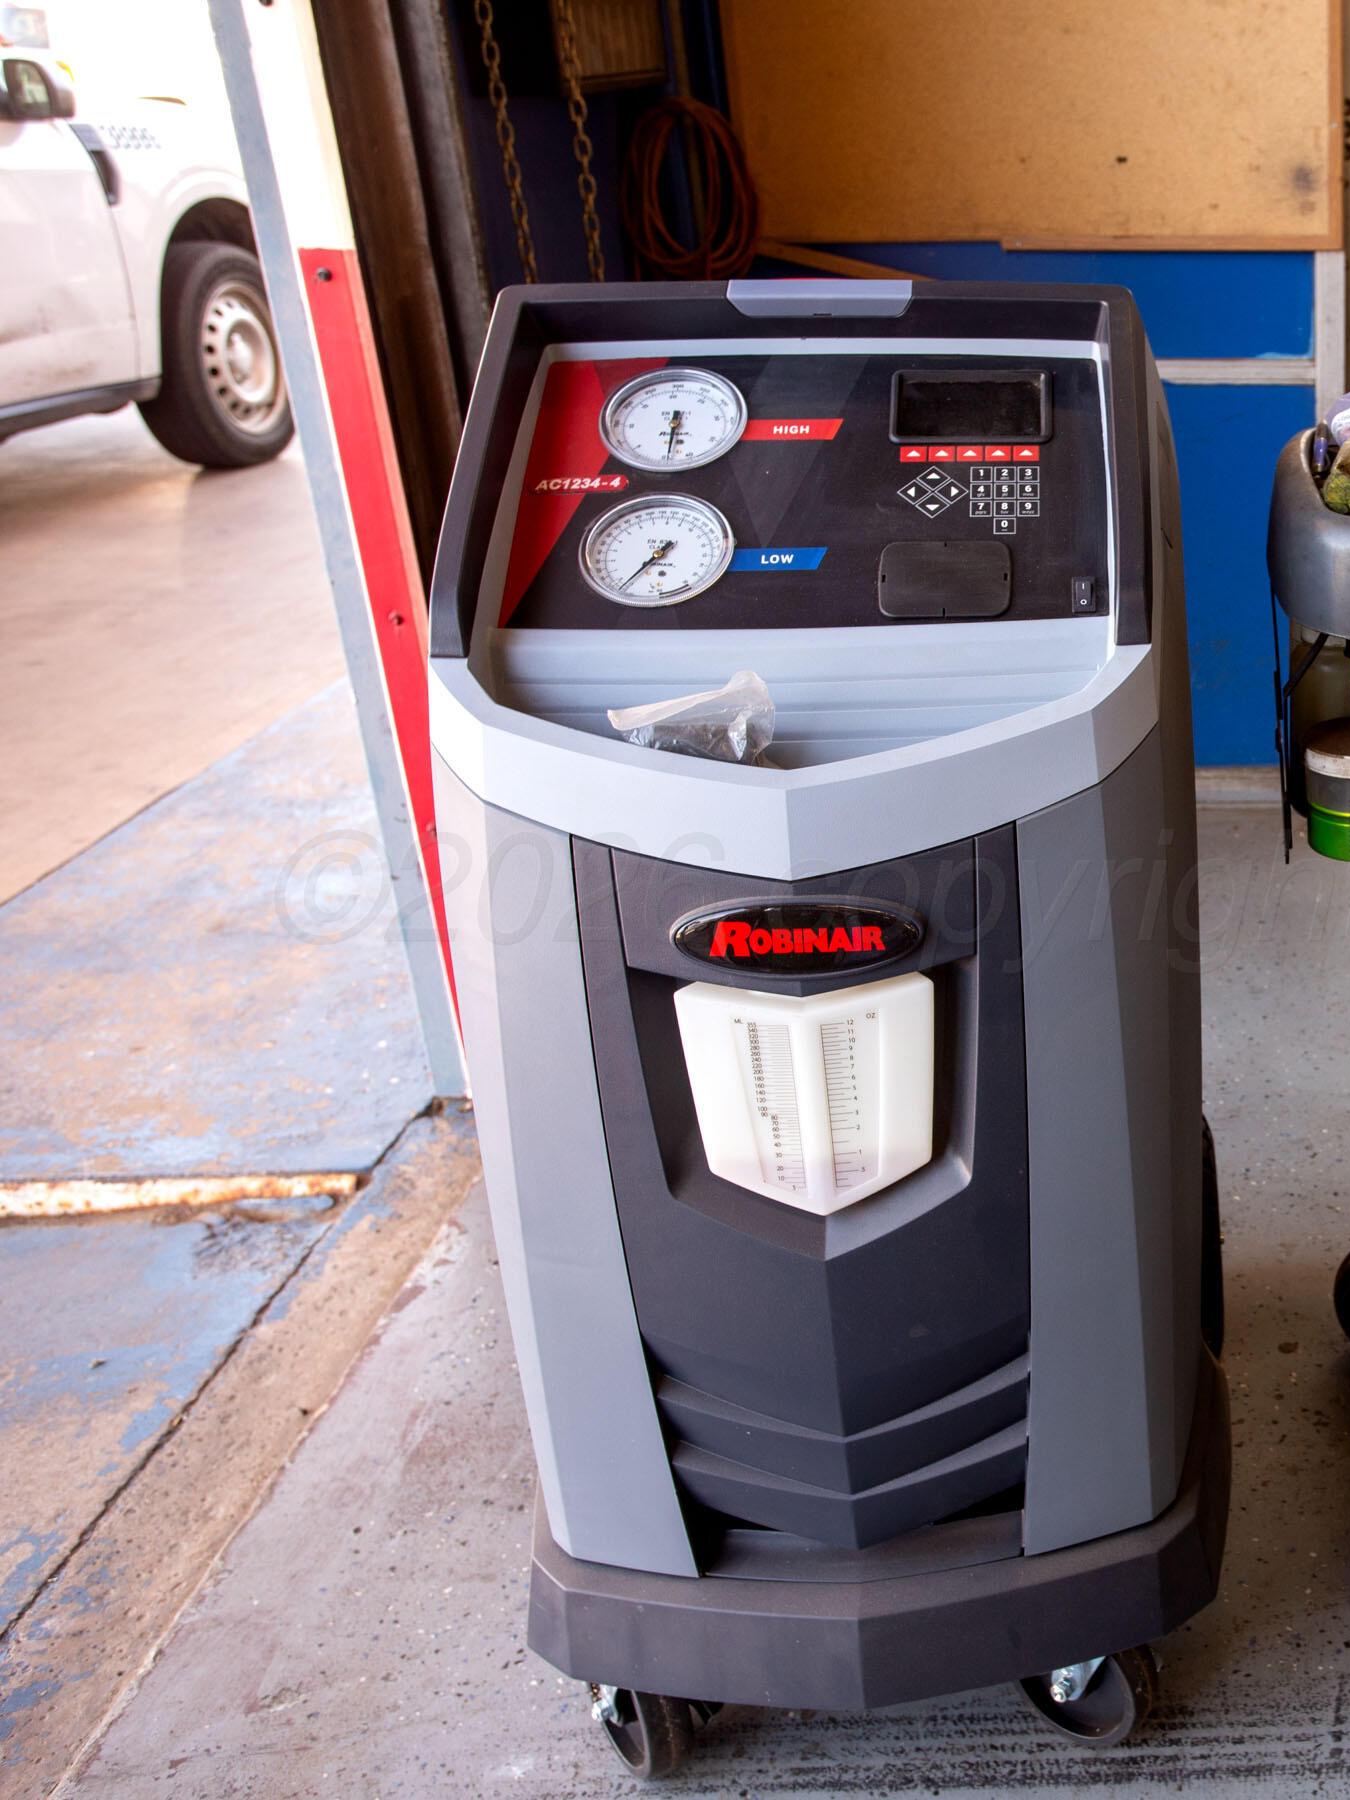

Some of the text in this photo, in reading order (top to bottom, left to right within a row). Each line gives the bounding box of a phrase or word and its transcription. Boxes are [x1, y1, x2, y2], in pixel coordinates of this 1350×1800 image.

[772, 424, 810, 435] HIGH
[979, 469, 984, 477] 1
[1024, 468, 1032, 476] 3
[535, 476, 621, 491] AC1234-4
[977, 485, 1032, 493] 4 5 6
[977, 502, 1032, 510] 7 8 9
[1001, 520, 1008, 528] 0
[760, 554, 794, 564] LOW
[709, 921, 886, 957] ROBINAIR
